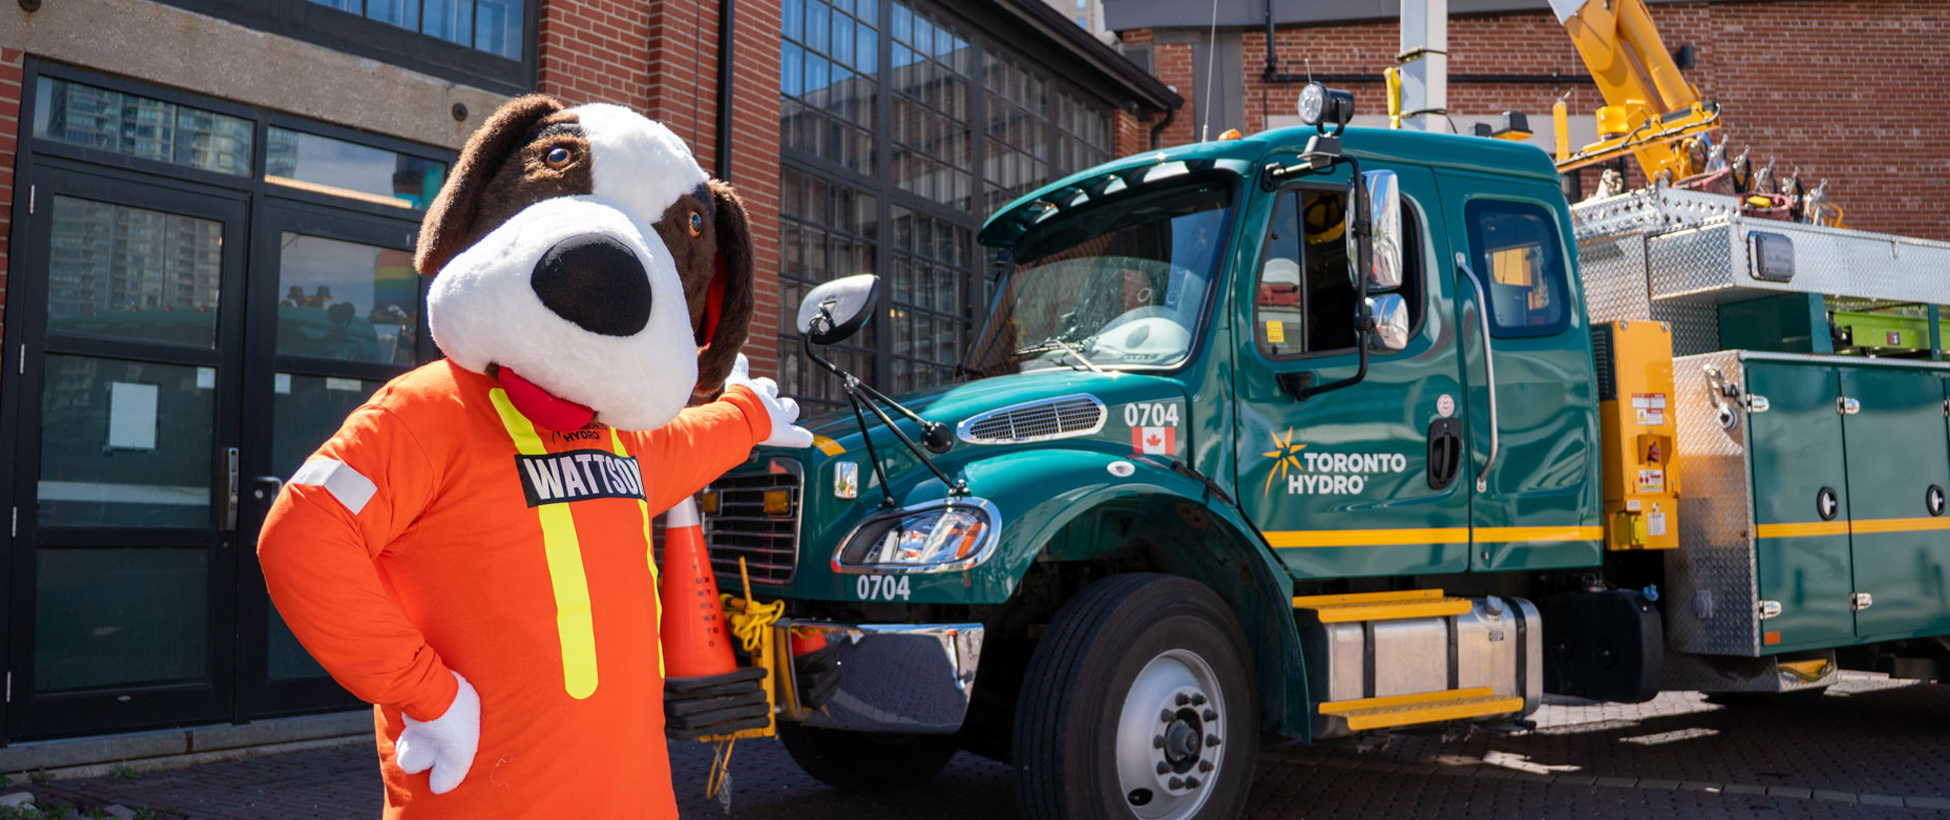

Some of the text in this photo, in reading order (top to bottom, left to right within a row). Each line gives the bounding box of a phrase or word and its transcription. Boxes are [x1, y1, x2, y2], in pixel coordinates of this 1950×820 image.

[1124, 402, 1179, 427] 0704
[563, 430, 600, 443] HYDRO
[1303, 452, 1407, 473] TORONTO
[523, 454, 646, 499] WATTSON
[1288, 474, 1364, 495] HYDRO
[857, 574, 911, 601] 0704
